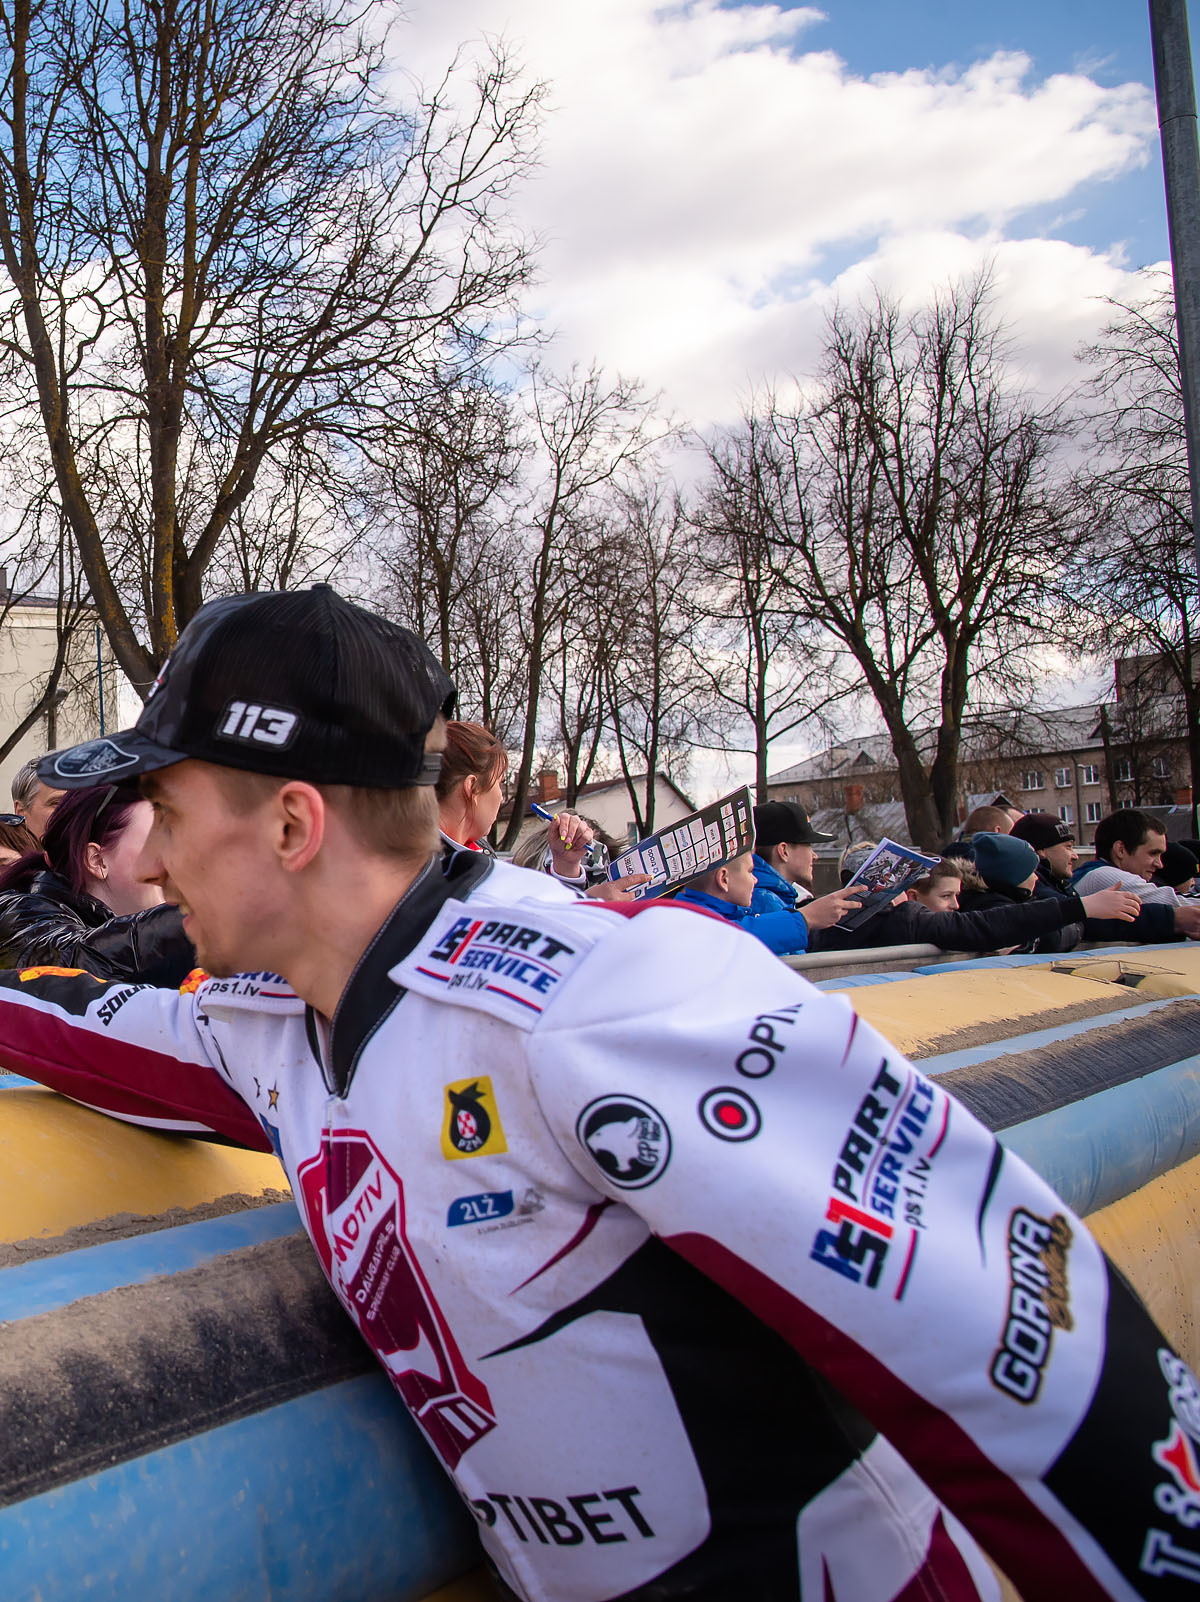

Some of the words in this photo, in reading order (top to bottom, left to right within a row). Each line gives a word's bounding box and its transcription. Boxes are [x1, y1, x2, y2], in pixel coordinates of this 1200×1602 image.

[222, 701, 297, 745] 113
[474, 920, 576, 961] PART
[208, 981, 261, 997] ps1.lv
[449, 970, 489, 991] ps1.lv
[458, 948, 559, 995] SERVICE
[457, 1136, 484, 1151] PZM
[832, 1057, 901, 1203] PART
[869, 1075, 935, 1221] SERVICE
[459, 1194, 500, 1222] 2LŻ
[904, 1157, 934, 1230] ps1.lv
[355, 1220, 395, 1304] DAUGAVPILS
[992, 1211, 1052, 1403] GORINA
[468, 1486, 657, 1546] PTIBET
